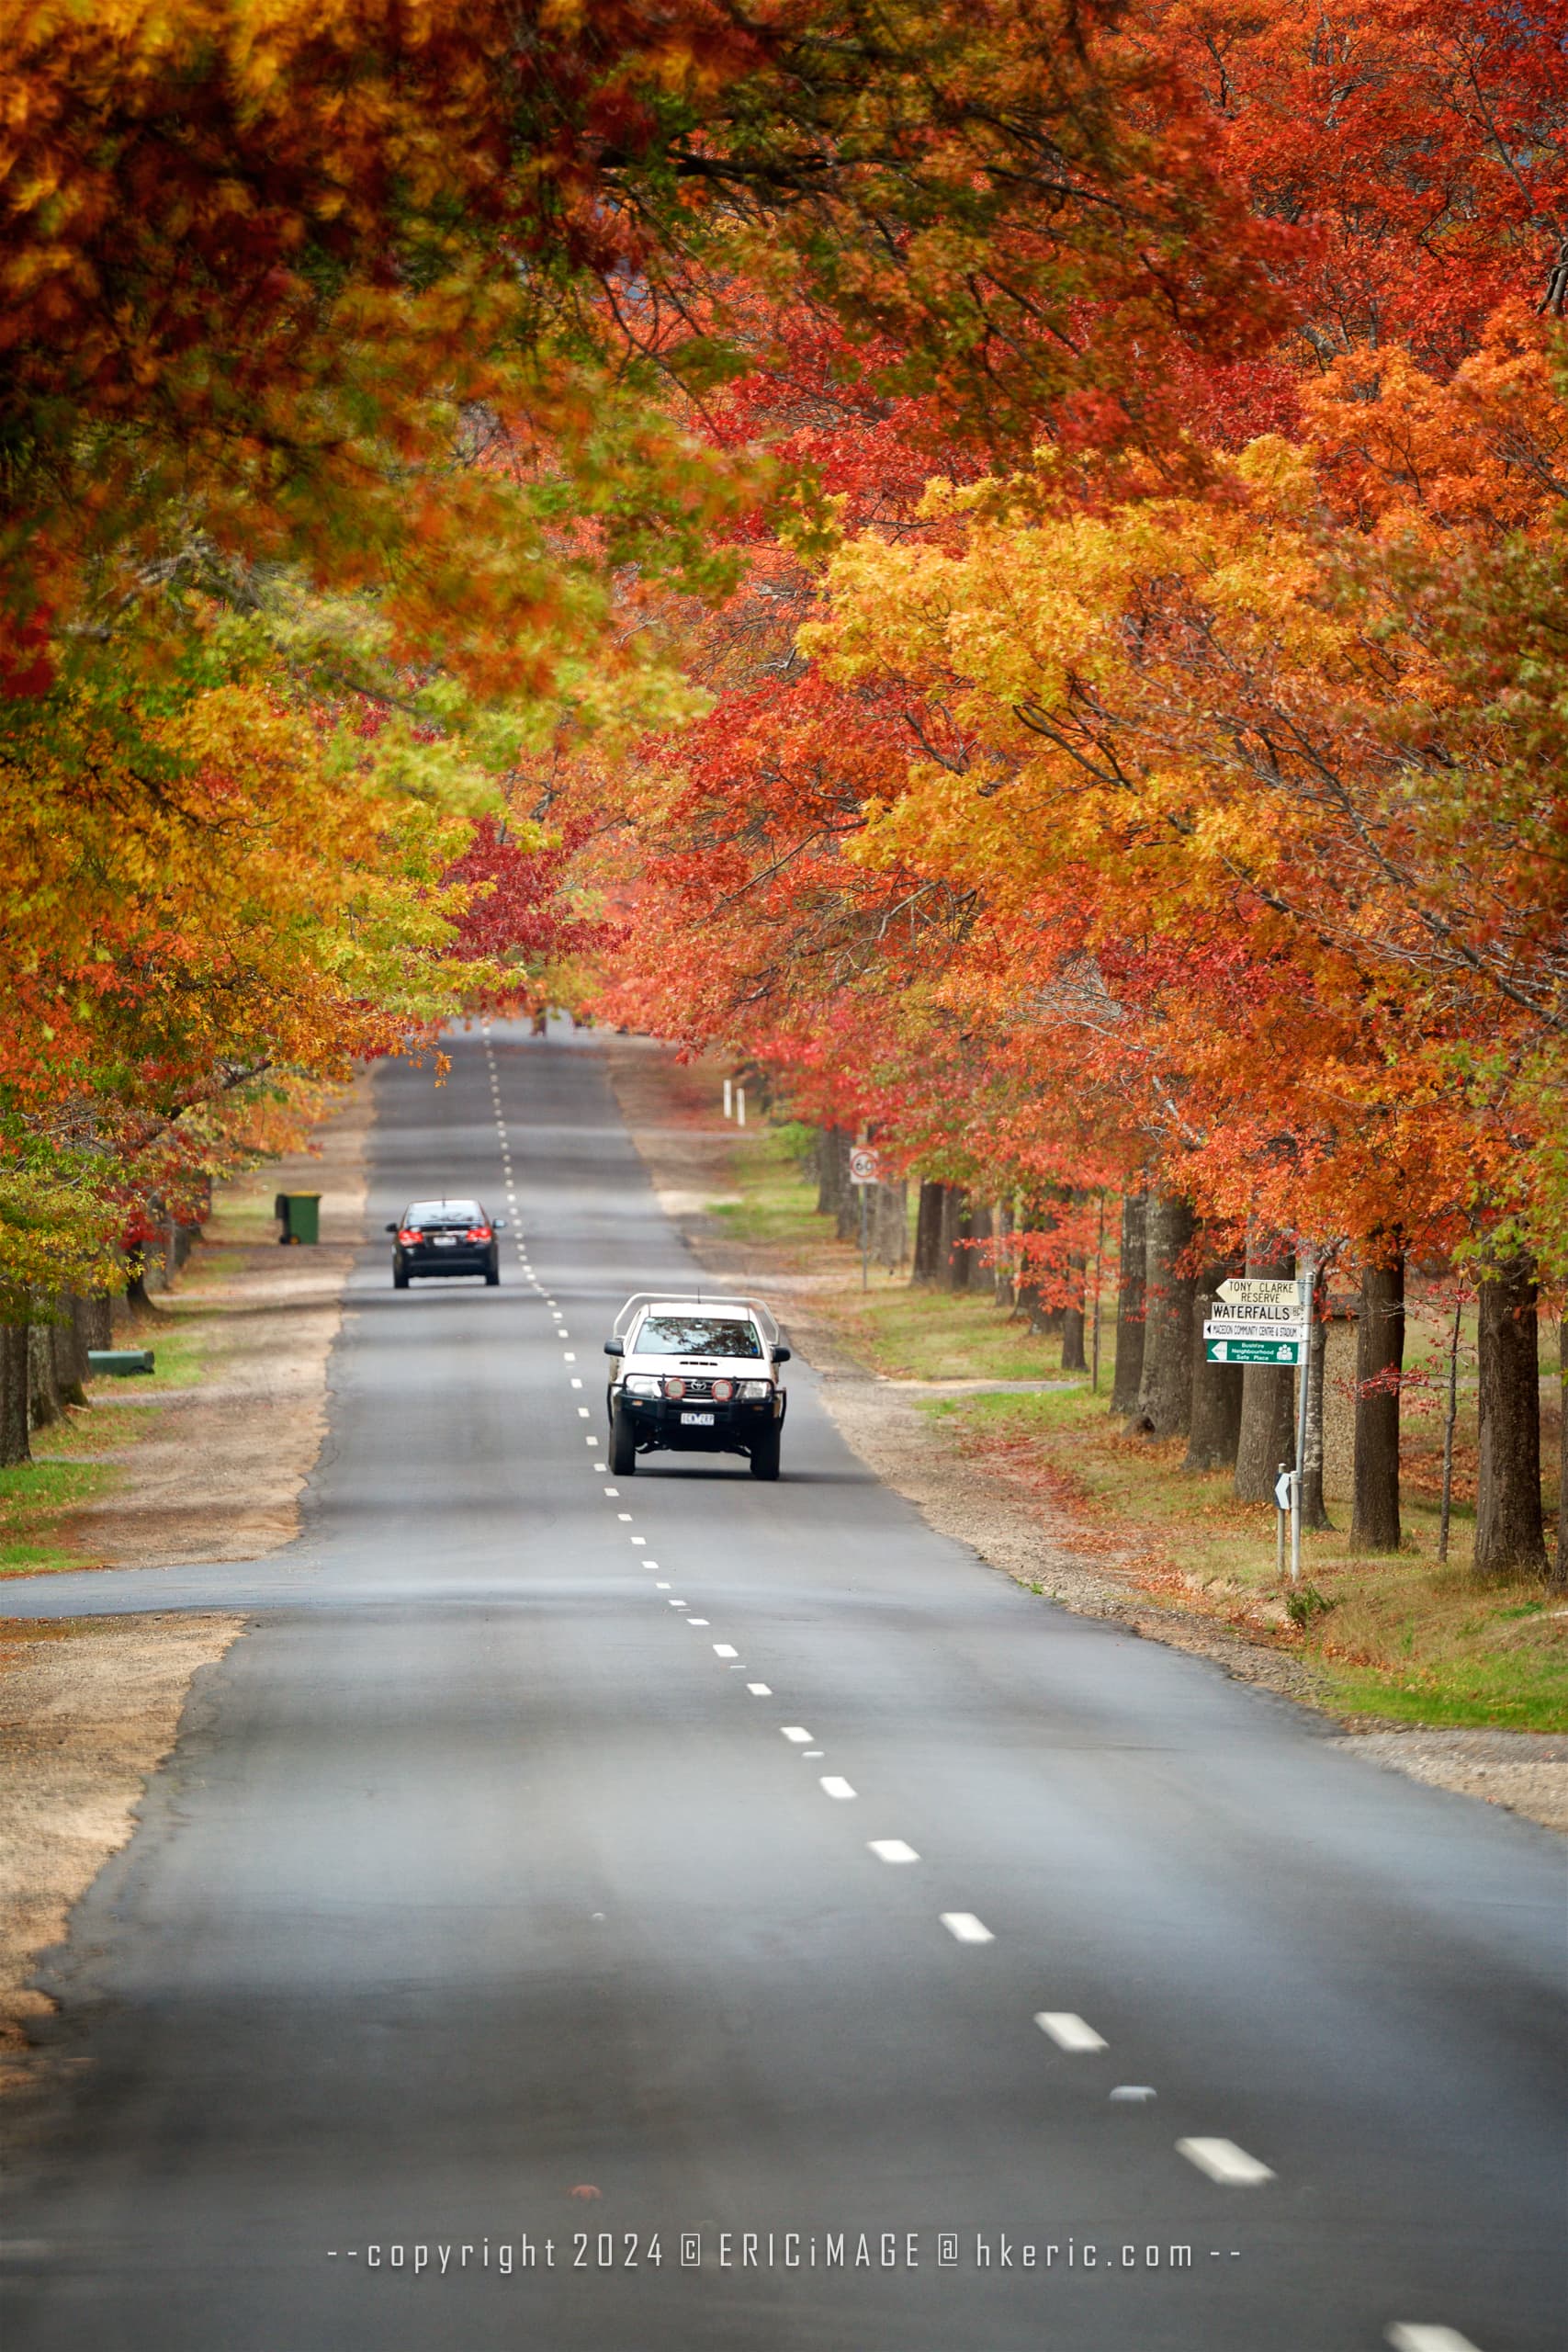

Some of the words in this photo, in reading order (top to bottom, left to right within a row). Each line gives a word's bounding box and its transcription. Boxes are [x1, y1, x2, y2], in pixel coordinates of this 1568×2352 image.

[855, 1159, 873, 1171] 60
[1229, 1281, 1252, 1292] TONY
[1258, 1283, 1293, 1294] CLARKE
[1241, 1293, 1280, 1304] RESERVE
[1213, 1305, 1290, 1320] WATERFALLS
[1213, 1324, 1233, 1335] MACEDON
[1234, 1325, 1258, 1337] COMMUNITY
[1259, 1326, 1275, 1337] CENTRE
[1280, 1327, 1297, 1338] STADIUM
